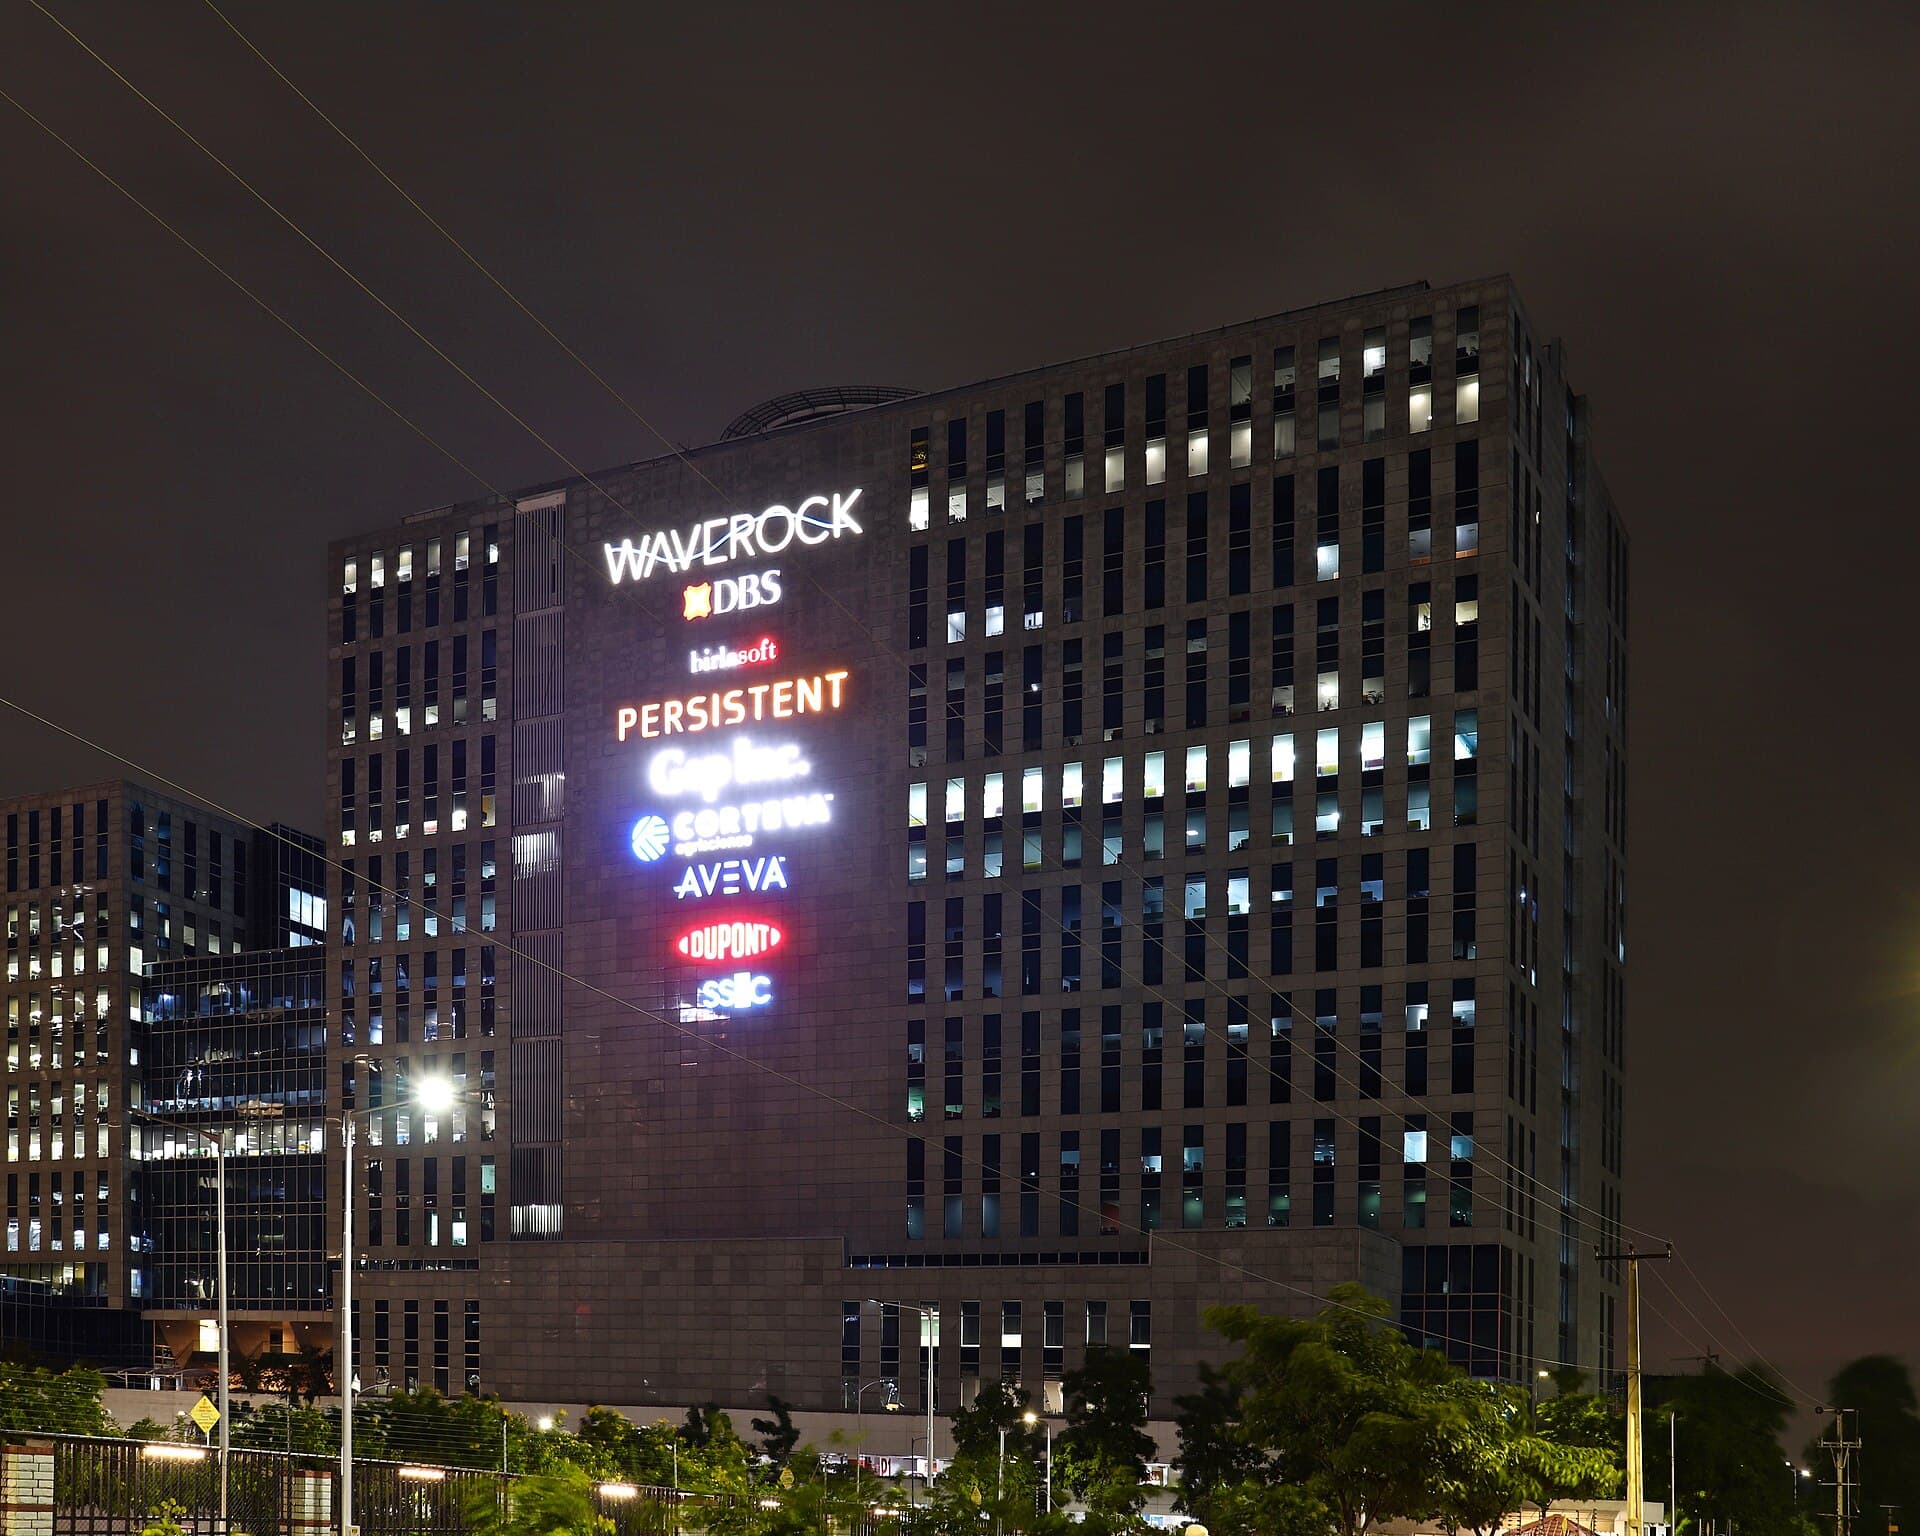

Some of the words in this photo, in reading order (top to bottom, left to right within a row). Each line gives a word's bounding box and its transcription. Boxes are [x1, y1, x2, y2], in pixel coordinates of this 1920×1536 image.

[604, 489, 863, 584] WAVEROCK
[713, 569, 781, 615] DBS
[617, 672, 848, 741] PERSISTENT
[673, 856, 788, 899] AVEVA
[690, 922, 770, 960] DUPONT
[702, 971, 772, 1009] SSC
